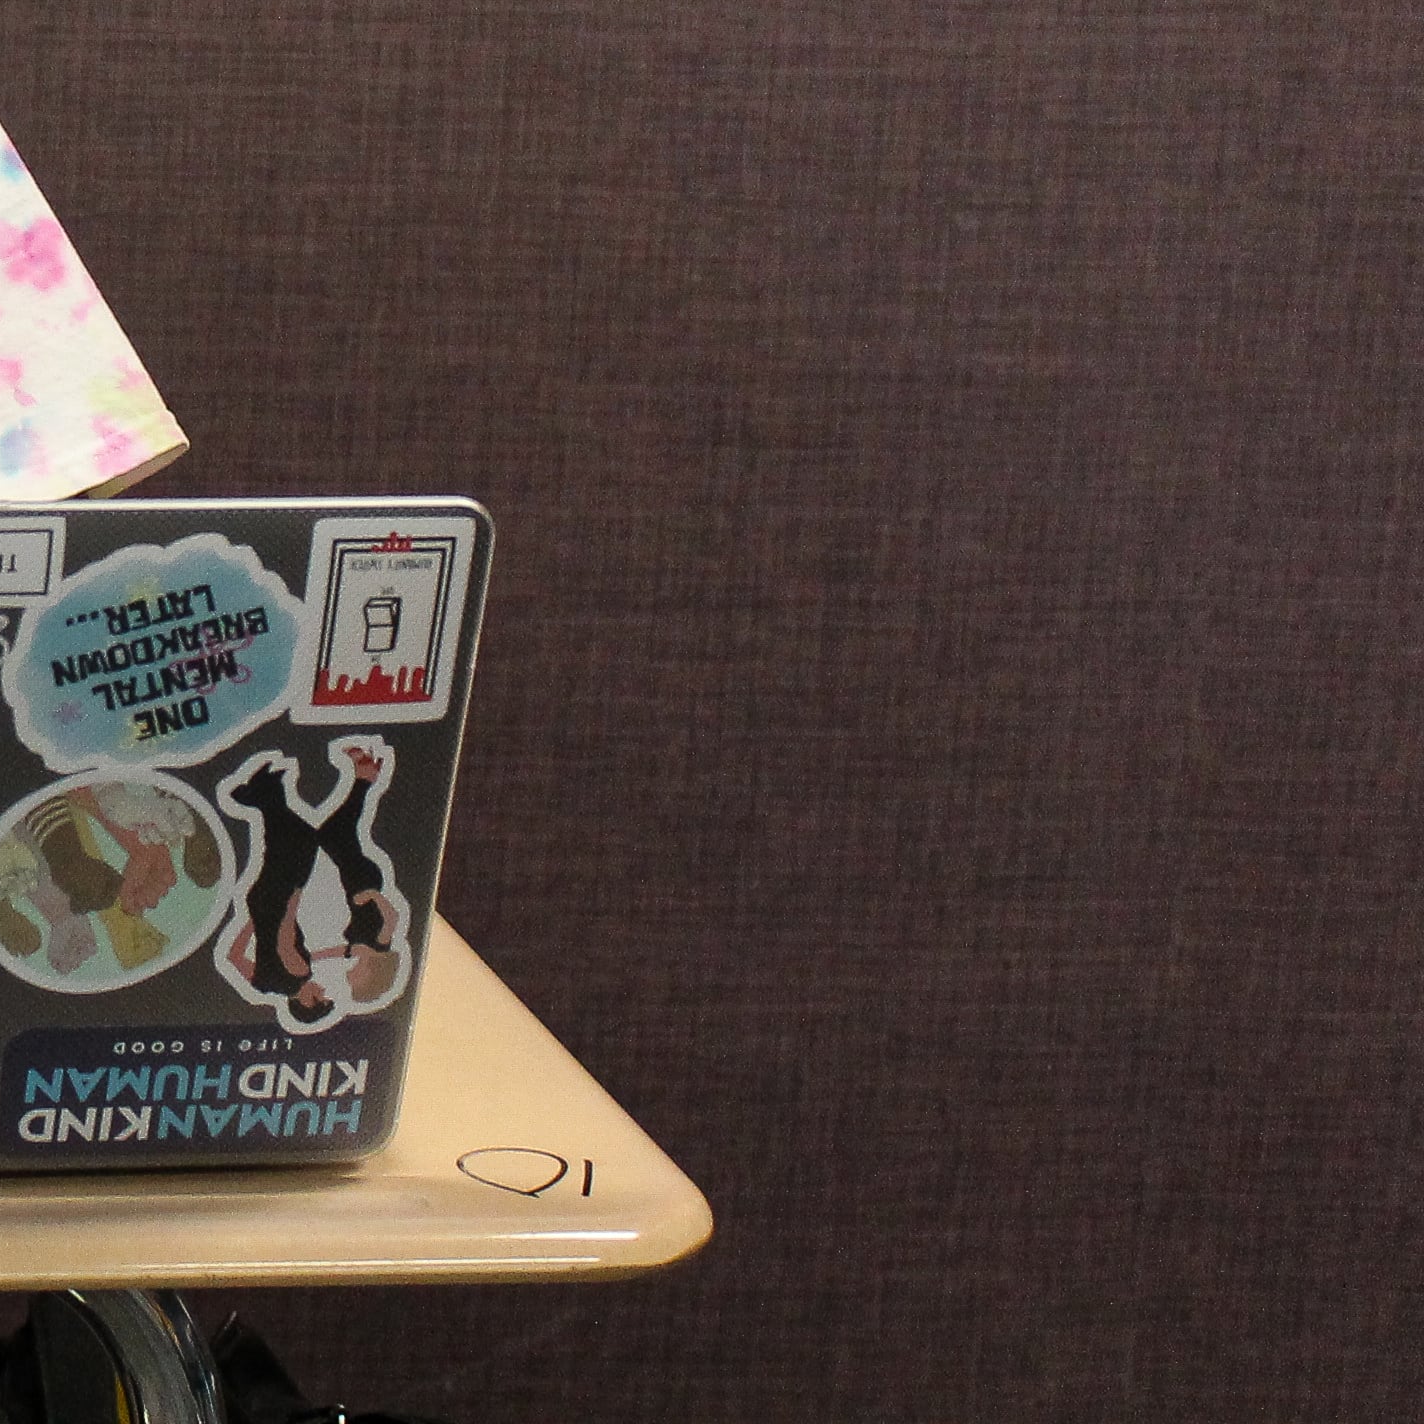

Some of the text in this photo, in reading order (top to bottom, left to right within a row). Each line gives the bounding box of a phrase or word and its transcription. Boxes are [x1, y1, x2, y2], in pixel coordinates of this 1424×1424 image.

[65, 584, 216, 636] LATER...
[50, 606, 270, 687] BREAKDOWN
[91, 650, 238, 711] MENTAL
[133, 696, 210, 742] ONE
[111, 1039, 185, 1055] GOOD
[200, 1039, 223, 1053] IS
